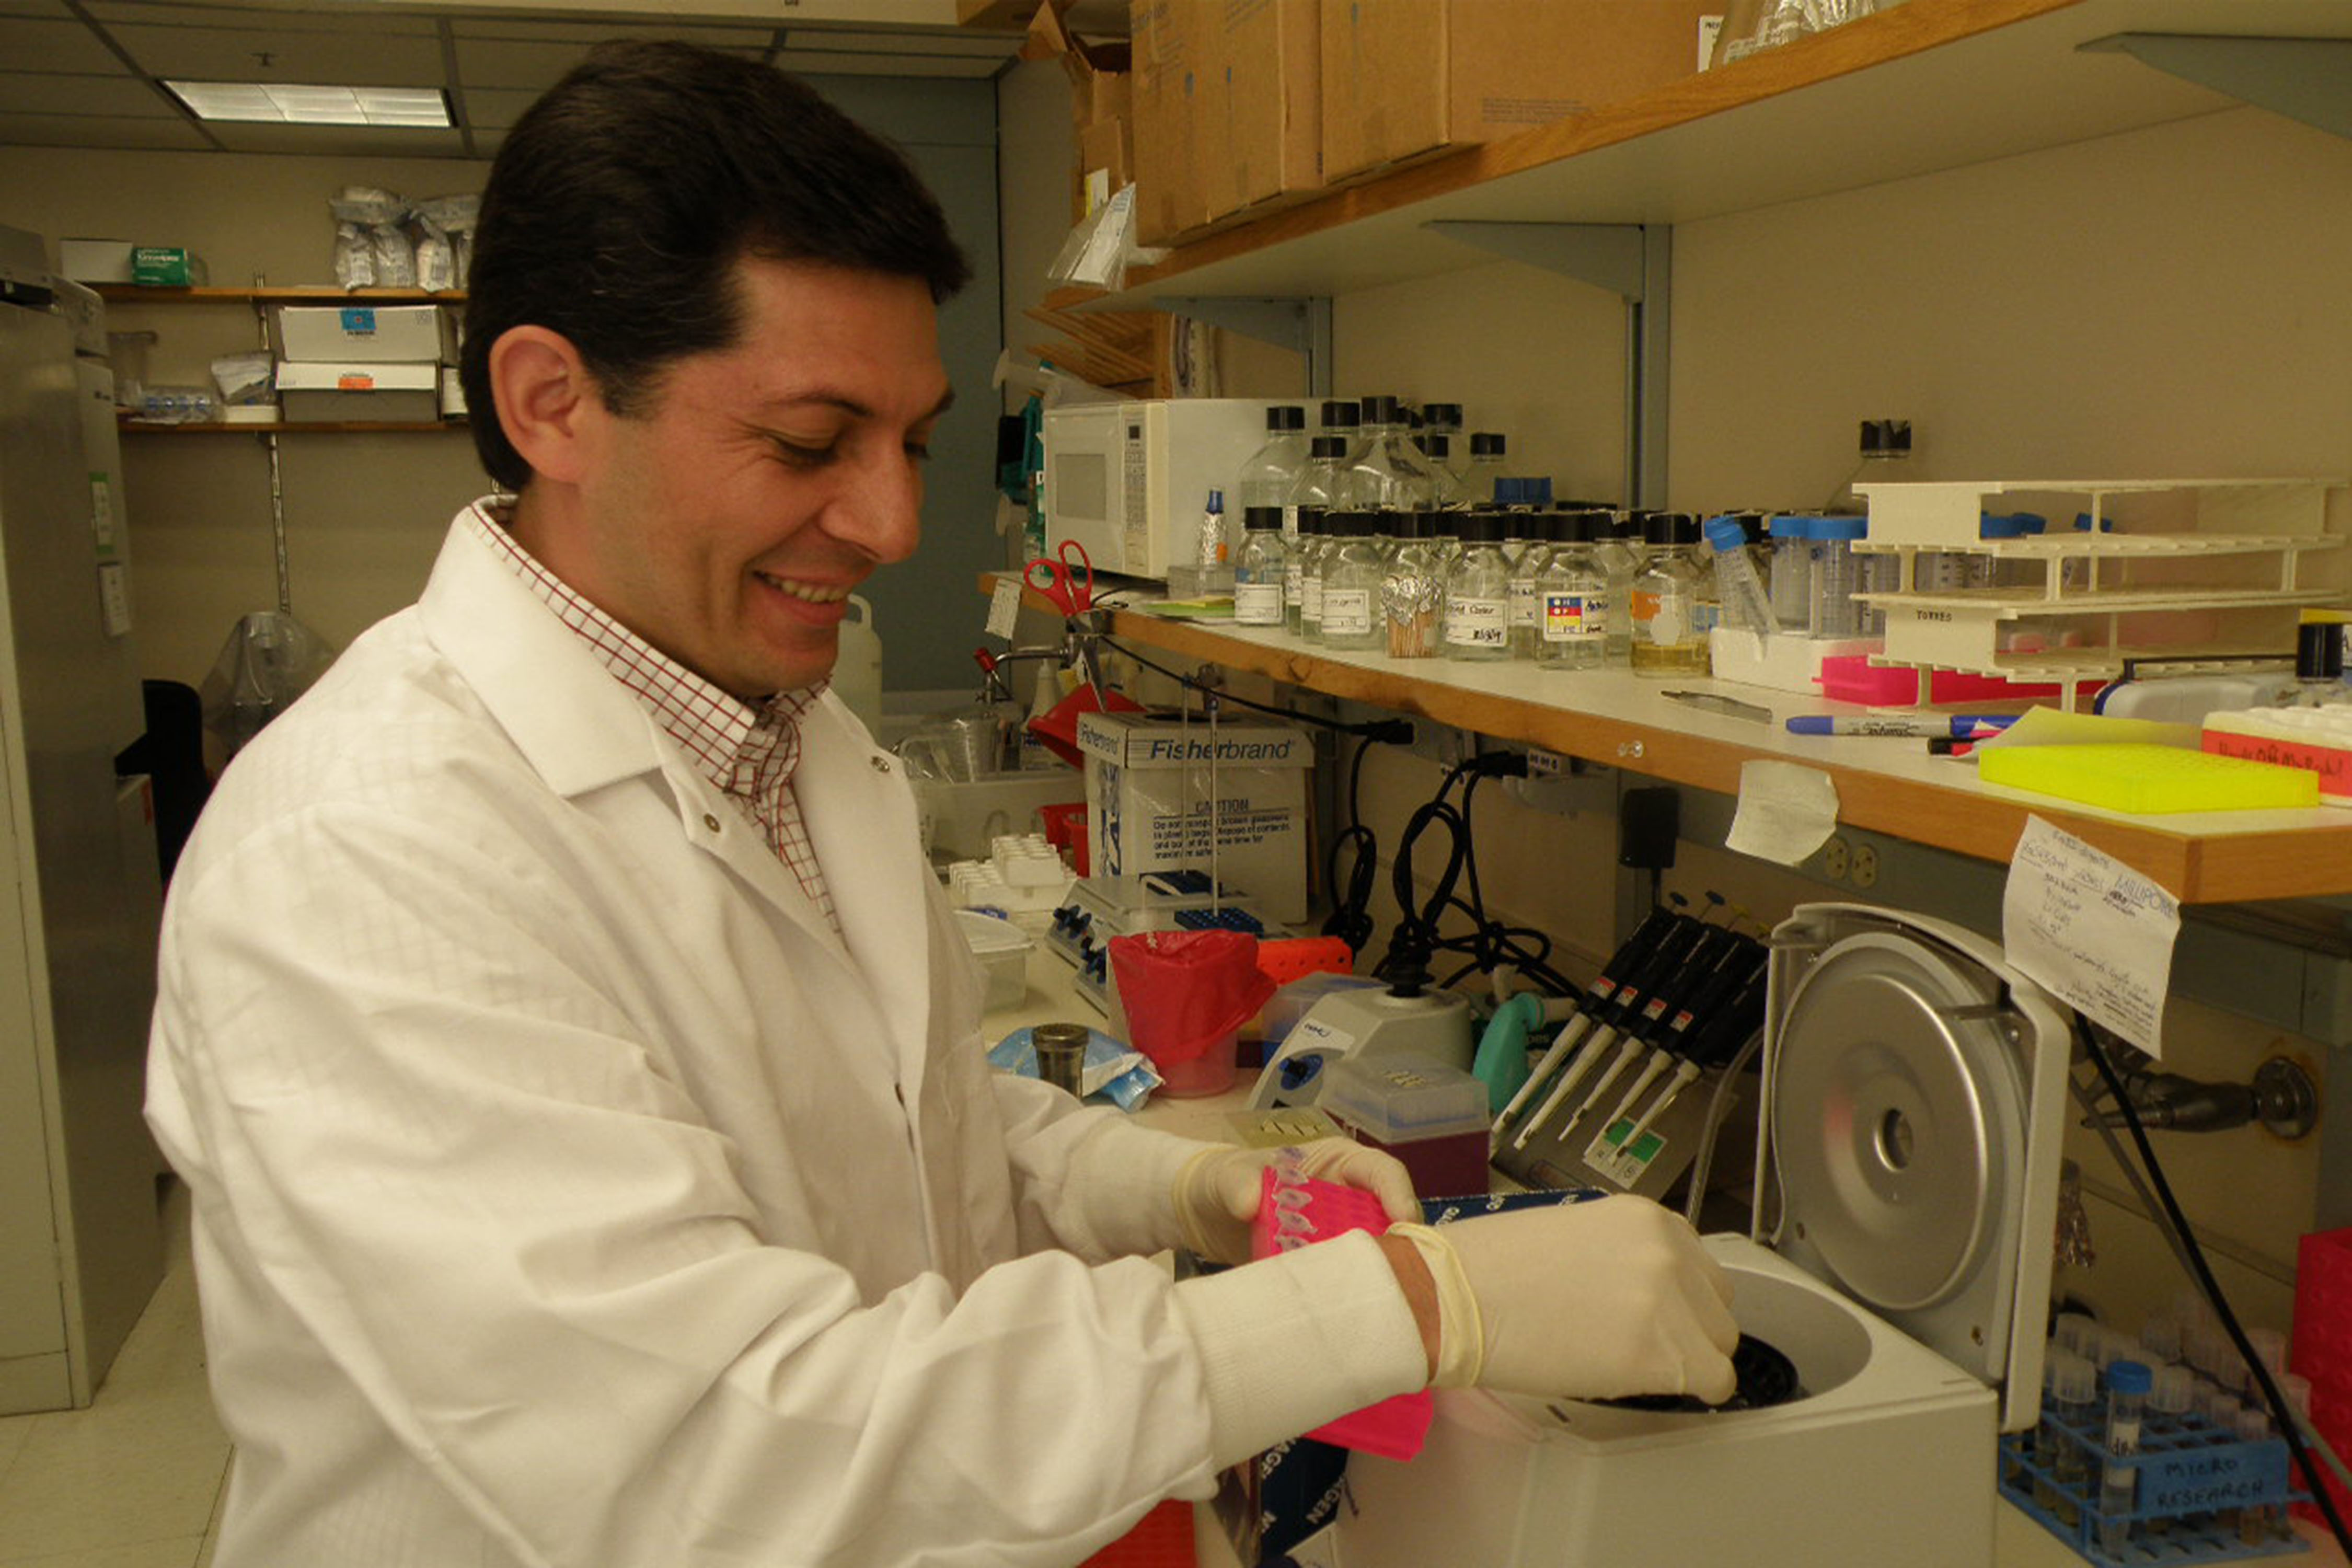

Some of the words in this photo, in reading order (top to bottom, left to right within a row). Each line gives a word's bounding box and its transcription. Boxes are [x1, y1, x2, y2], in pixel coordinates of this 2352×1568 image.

[1150, 739, 1292, 760] Fisherbrand
[2165, 1457, 2238, 1478] MICRO
[2158, 1479, 2264, 1508] RESEARCH
